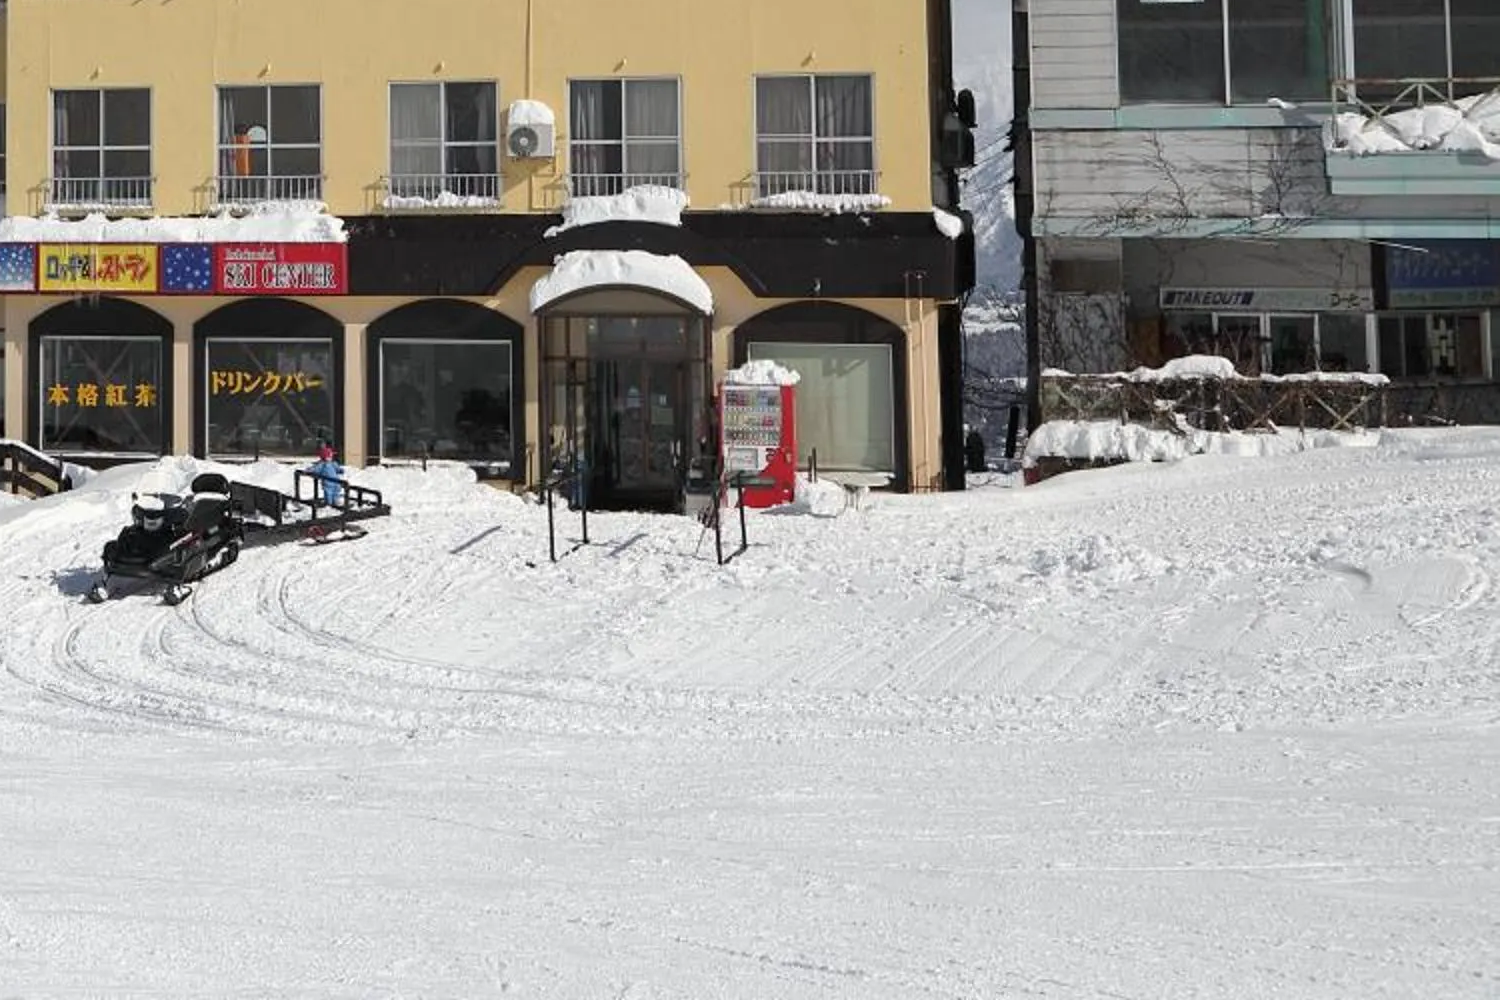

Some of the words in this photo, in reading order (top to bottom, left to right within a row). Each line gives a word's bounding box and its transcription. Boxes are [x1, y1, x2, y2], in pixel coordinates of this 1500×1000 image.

[261, 262, 337, 289] CENTER
[1175, 291, 1244, 306] TAKEOUT
[48, 383, 157, 407] 本格紅茶
[211, 371, 323, 395] ドリンクバー
